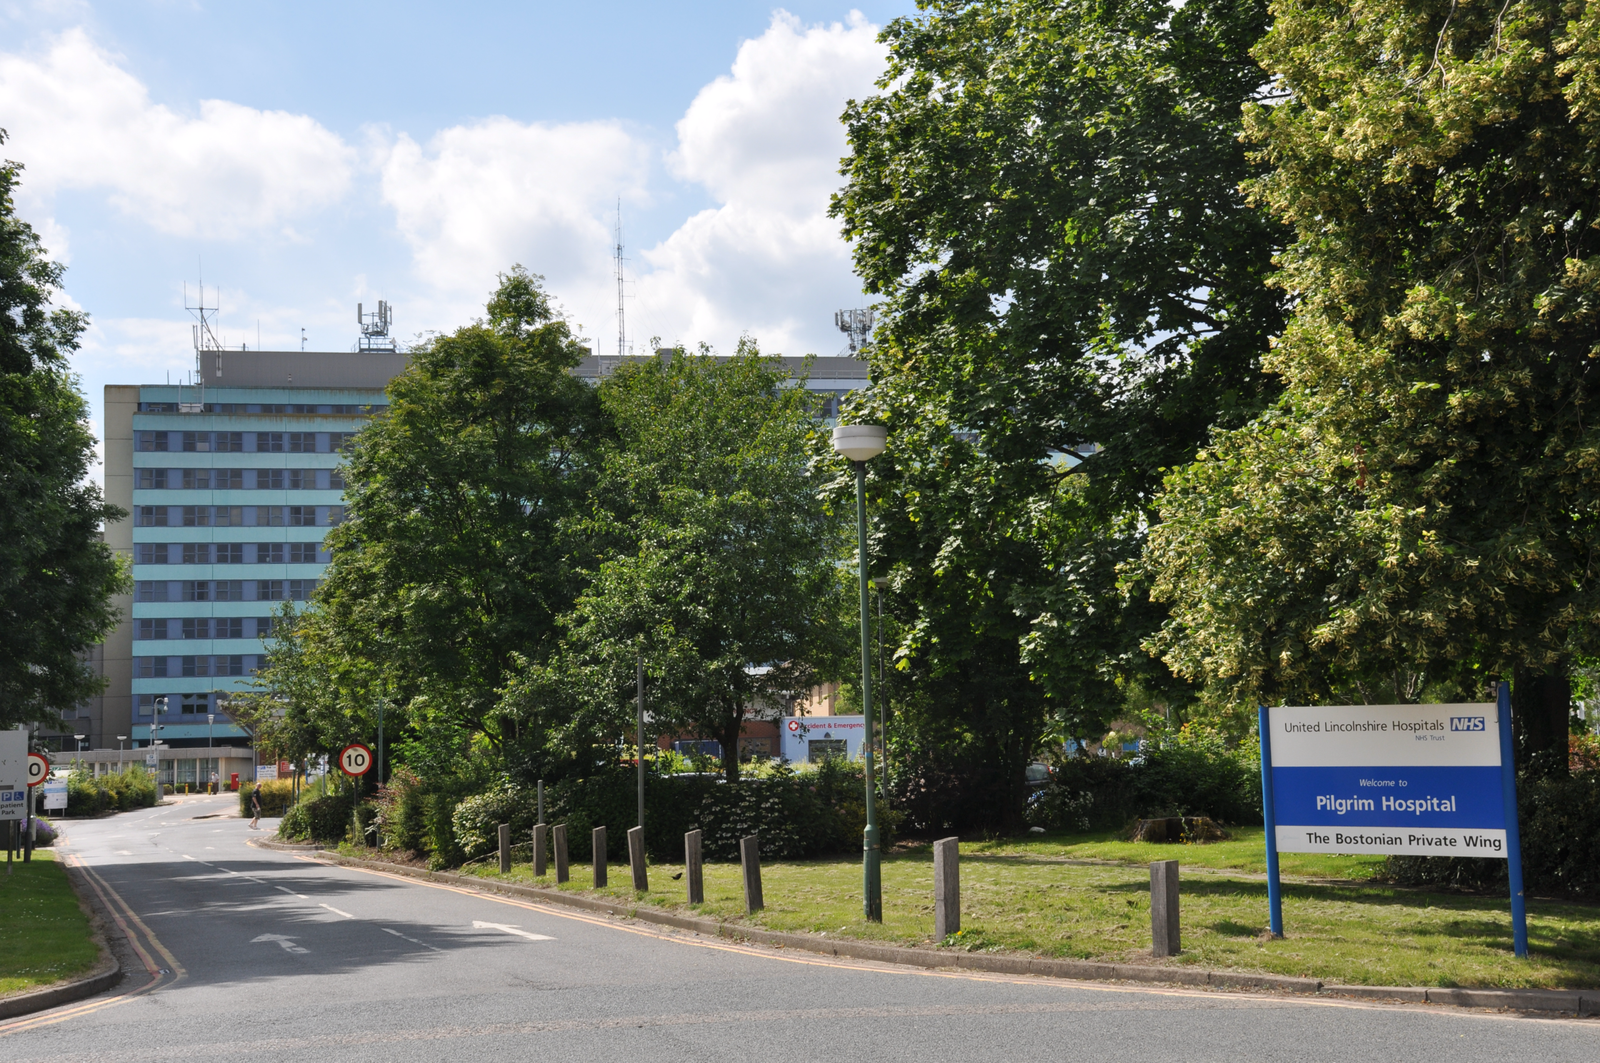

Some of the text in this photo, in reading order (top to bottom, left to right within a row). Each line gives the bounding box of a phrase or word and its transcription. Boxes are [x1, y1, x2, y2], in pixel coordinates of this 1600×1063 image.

[1284, 719, 1445, 734] United Lincolnshire Hospitals
[1451, 717, 1483, 731] NHS
[346, 753, 365, 767] 10
[29, 762, 41, 776] 0
[1360, 779, 1408, 787] Welcome to
[1316, 795, 1456, 815] Pilgrim Hospital
[1306, 832, 1502, 851] The Bostonian Private Wing
